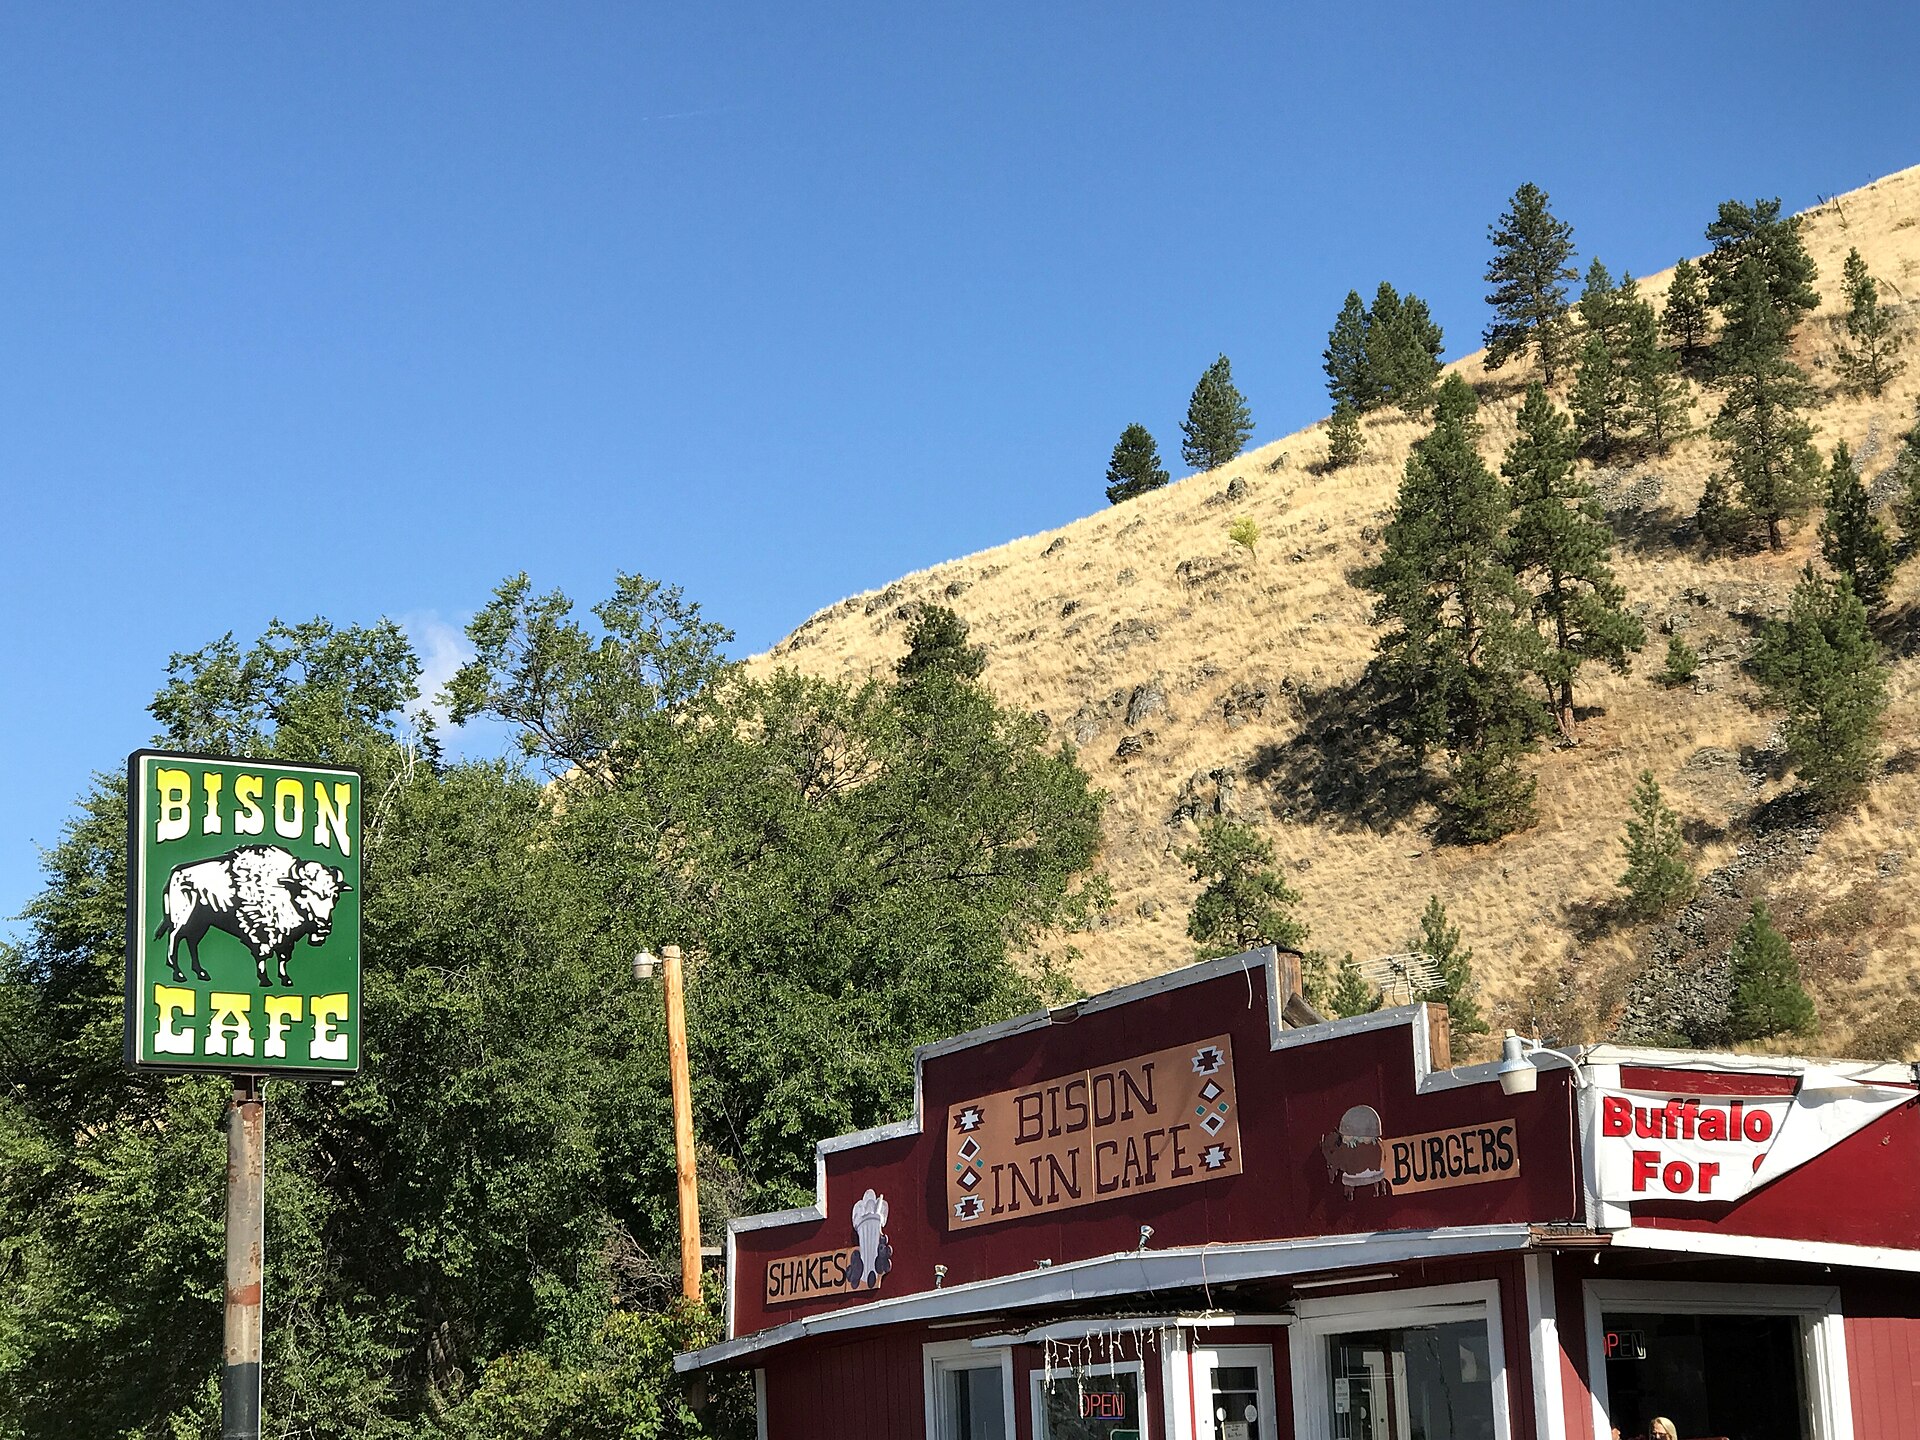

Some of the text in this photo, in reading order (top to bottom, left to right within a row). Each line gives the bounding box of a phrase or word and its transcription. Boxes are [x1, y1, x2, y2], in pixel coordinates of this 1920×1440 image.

[156, 768, 352, 857] BISON
[153, 983, 349, 1060] CAFE
[1013, 1062, 1158, 1145] BISON
[1602, 1096, 1773, 1142] Buffalo
[991, 1124, 1194, 1215] INN CAFE
[1391, 1125, 1514, 1186] BURGERS
[1632, 1150, 1720, 1194] For
[769, 1253, 846, 1297] SHAKES
[1079, 1394, 1124, 1417] OPEN
